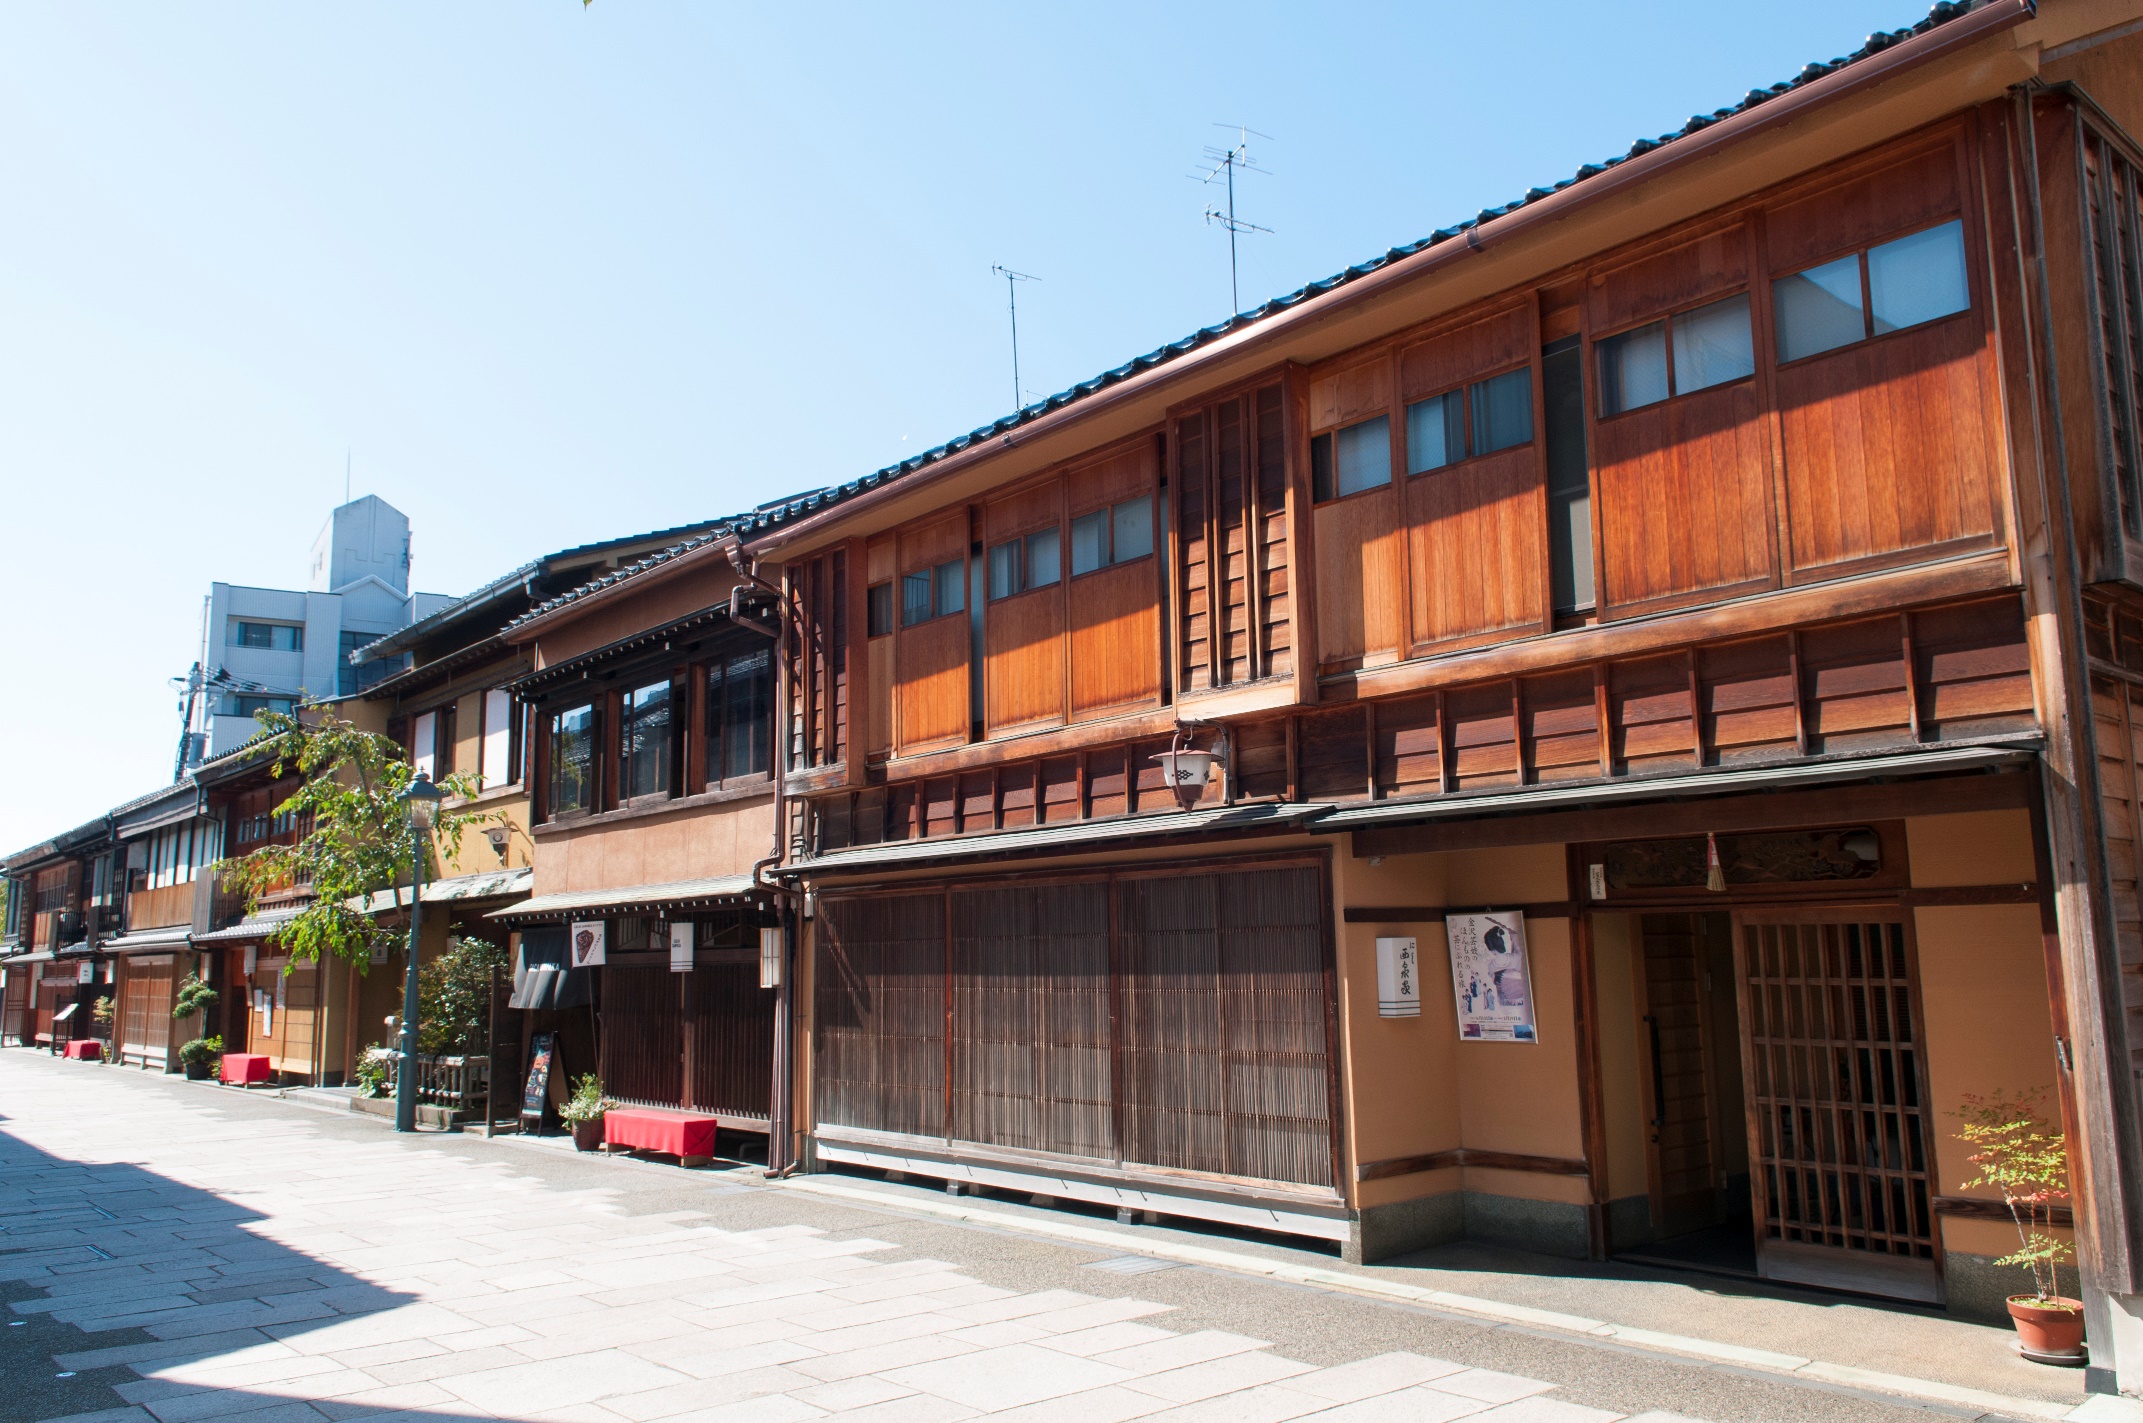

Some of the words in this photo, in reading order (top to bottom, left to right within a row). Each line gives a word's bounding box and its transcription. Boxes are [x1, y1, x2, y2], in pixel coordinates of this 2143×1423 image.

[1461, 927, 1470, 969] ほんものの
